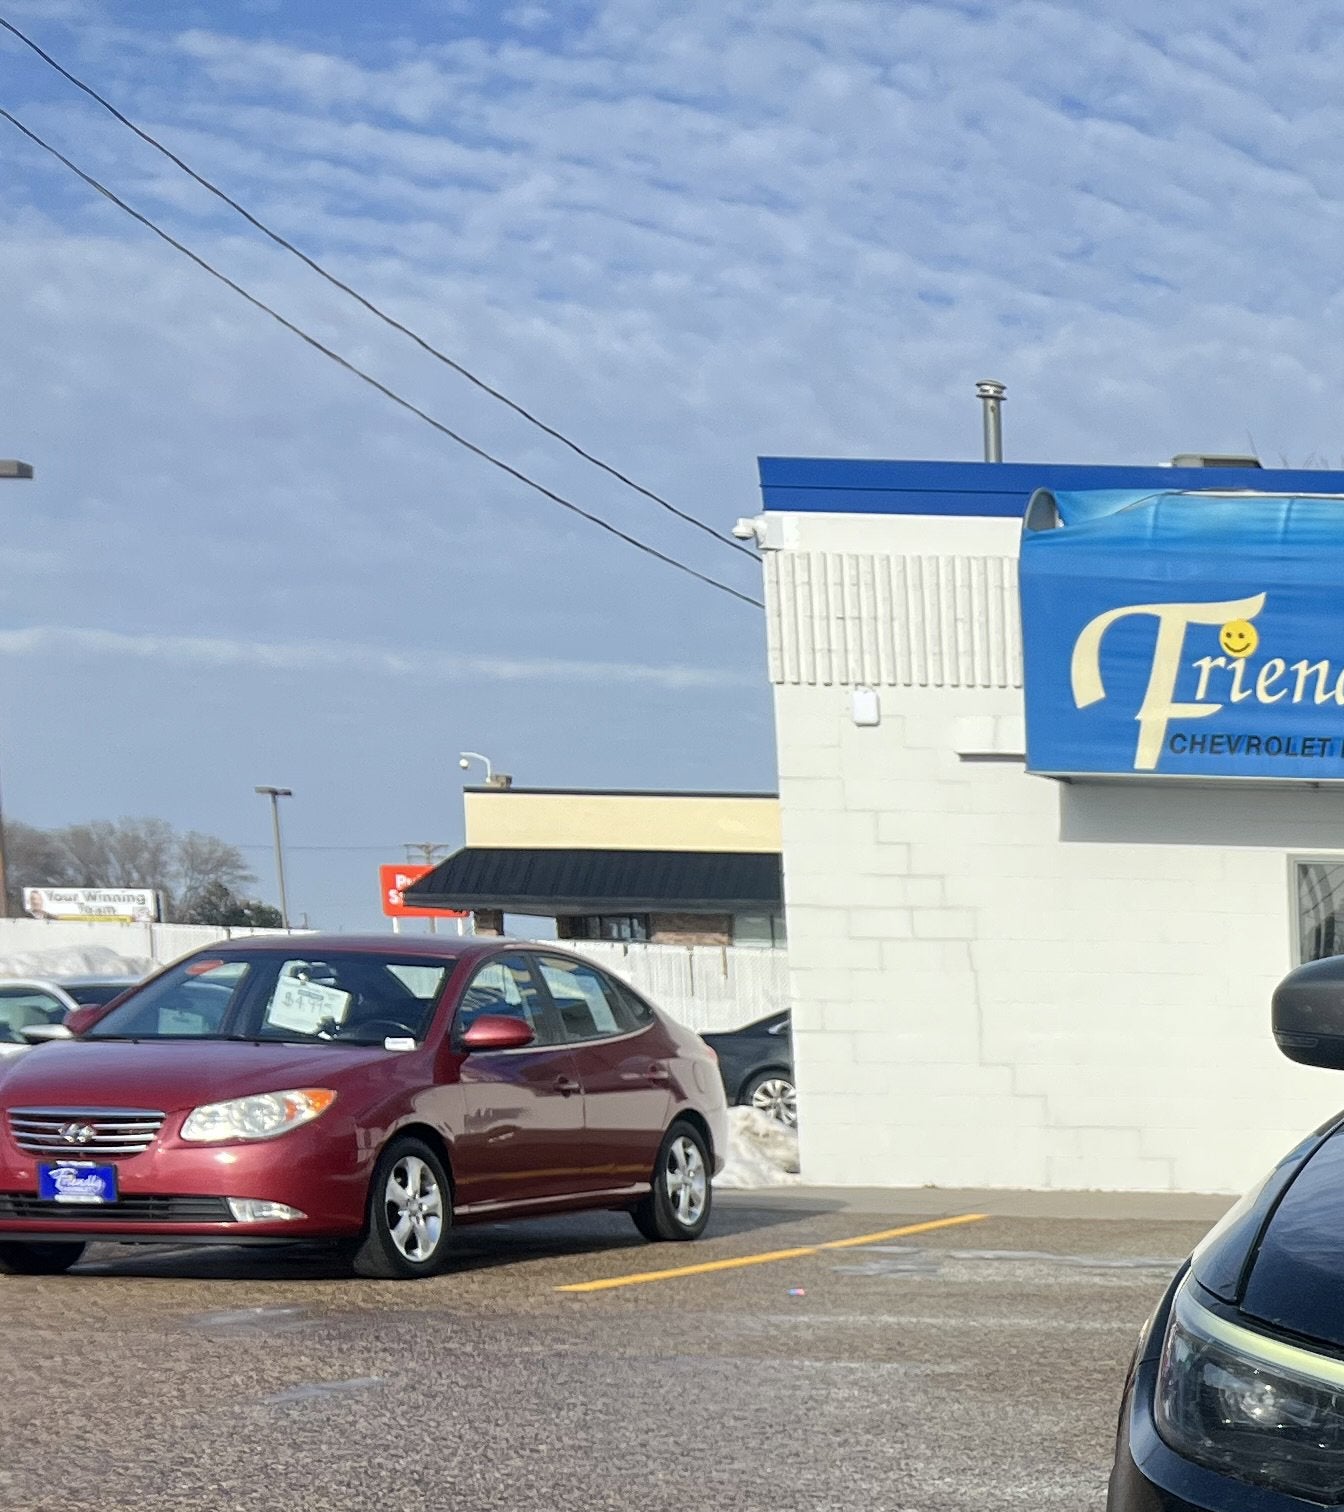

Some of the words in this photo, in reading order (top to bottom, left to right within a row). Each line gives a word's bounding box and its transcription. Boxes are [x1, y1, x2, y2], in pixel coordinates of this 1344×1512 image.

[1169, 733, 1330, 758] CHEVROLET
[45, 889, 78, 902] Your
[82, 890, 146, 905] Winning
